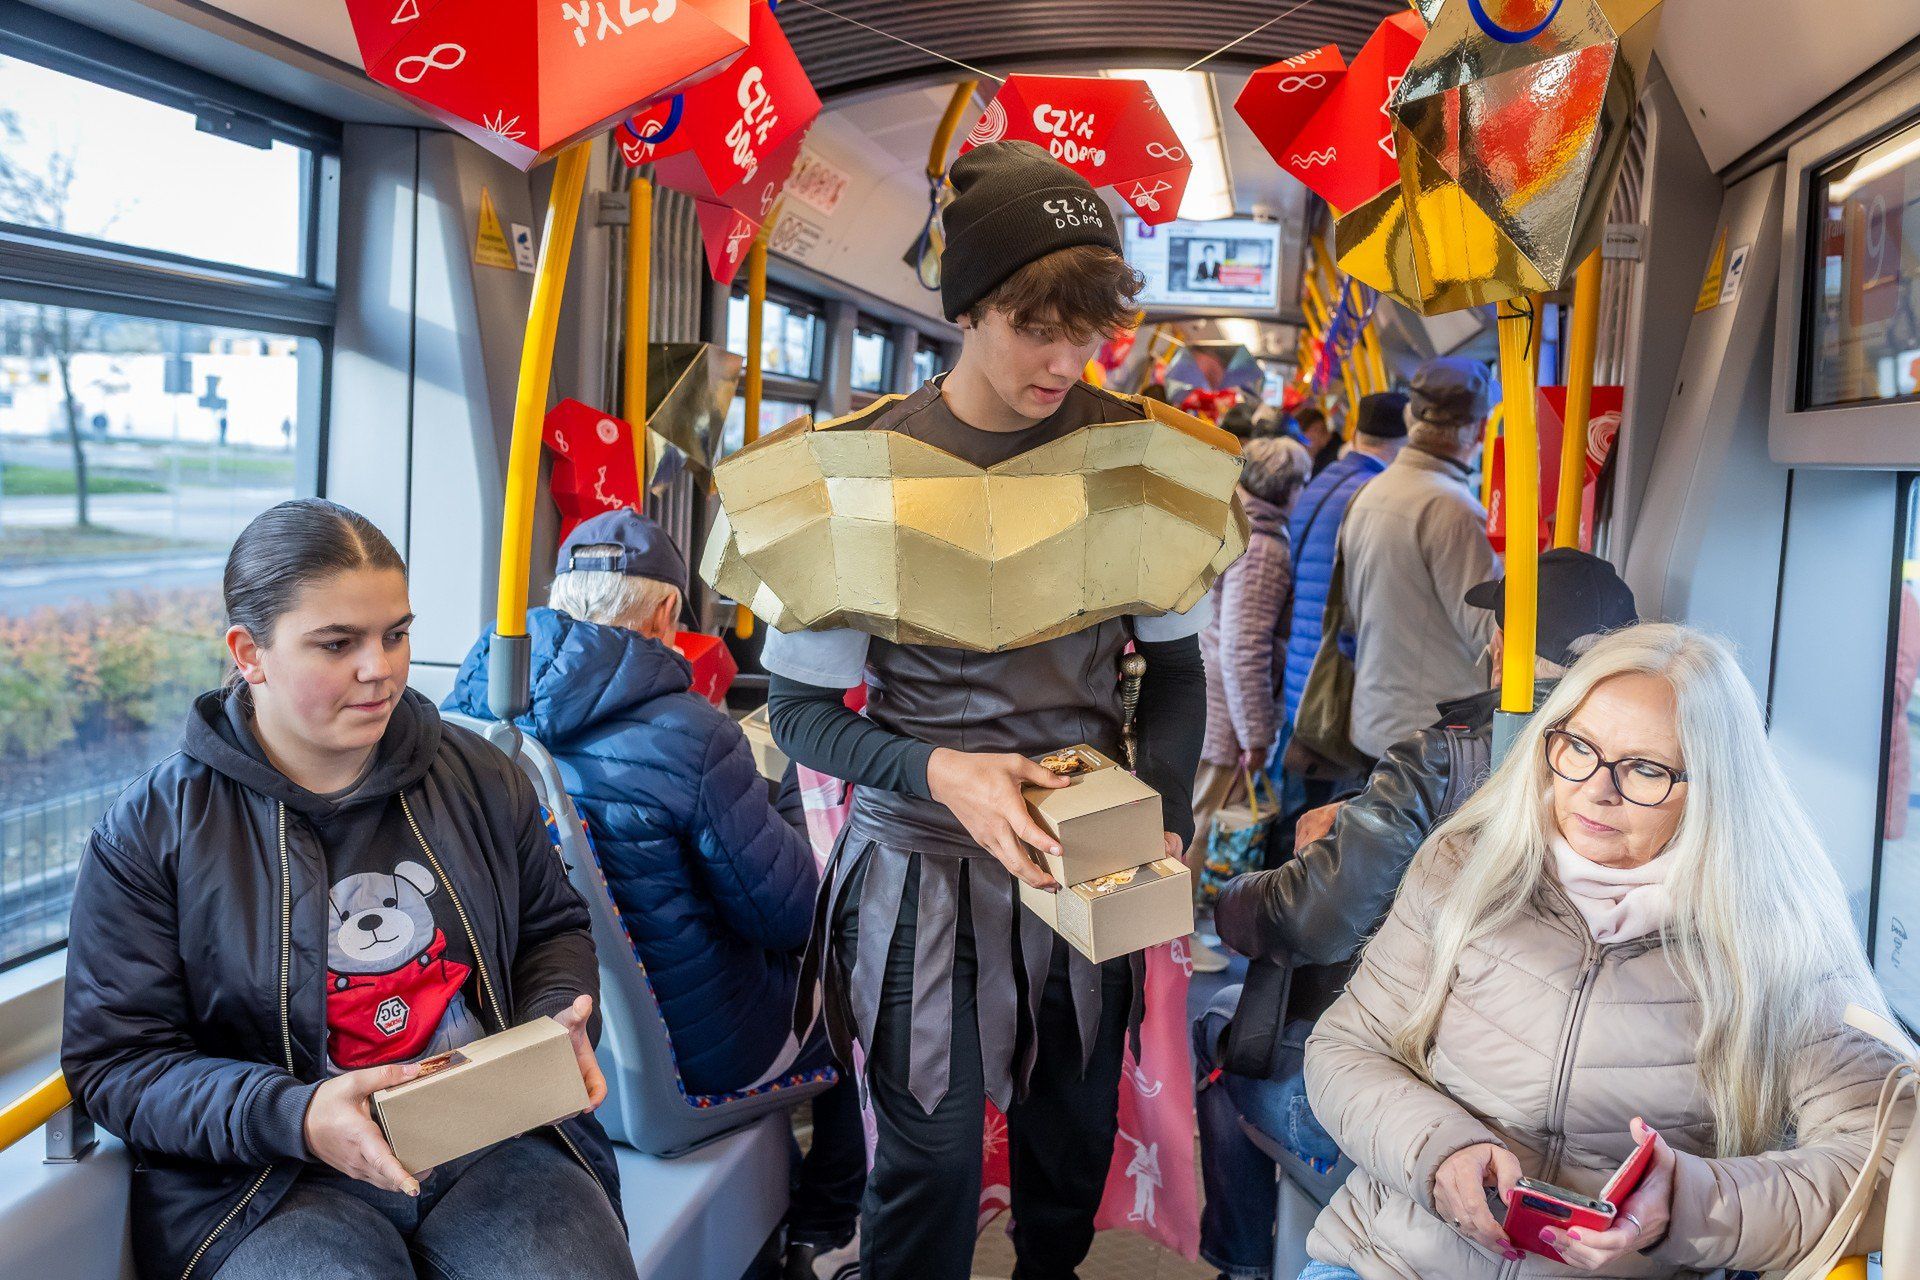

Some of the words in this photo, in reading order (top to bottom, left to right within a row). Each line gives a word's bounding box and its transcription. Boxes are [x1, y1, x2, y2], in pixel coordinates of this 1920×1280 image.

[737, 66, 779, 146] CZYŃ
[1033, 103, 1095, 140] CZYŃ
[1049, 138, 1106, 167] DOBRO
[1055, 214, 1103, 229] DOBRO
